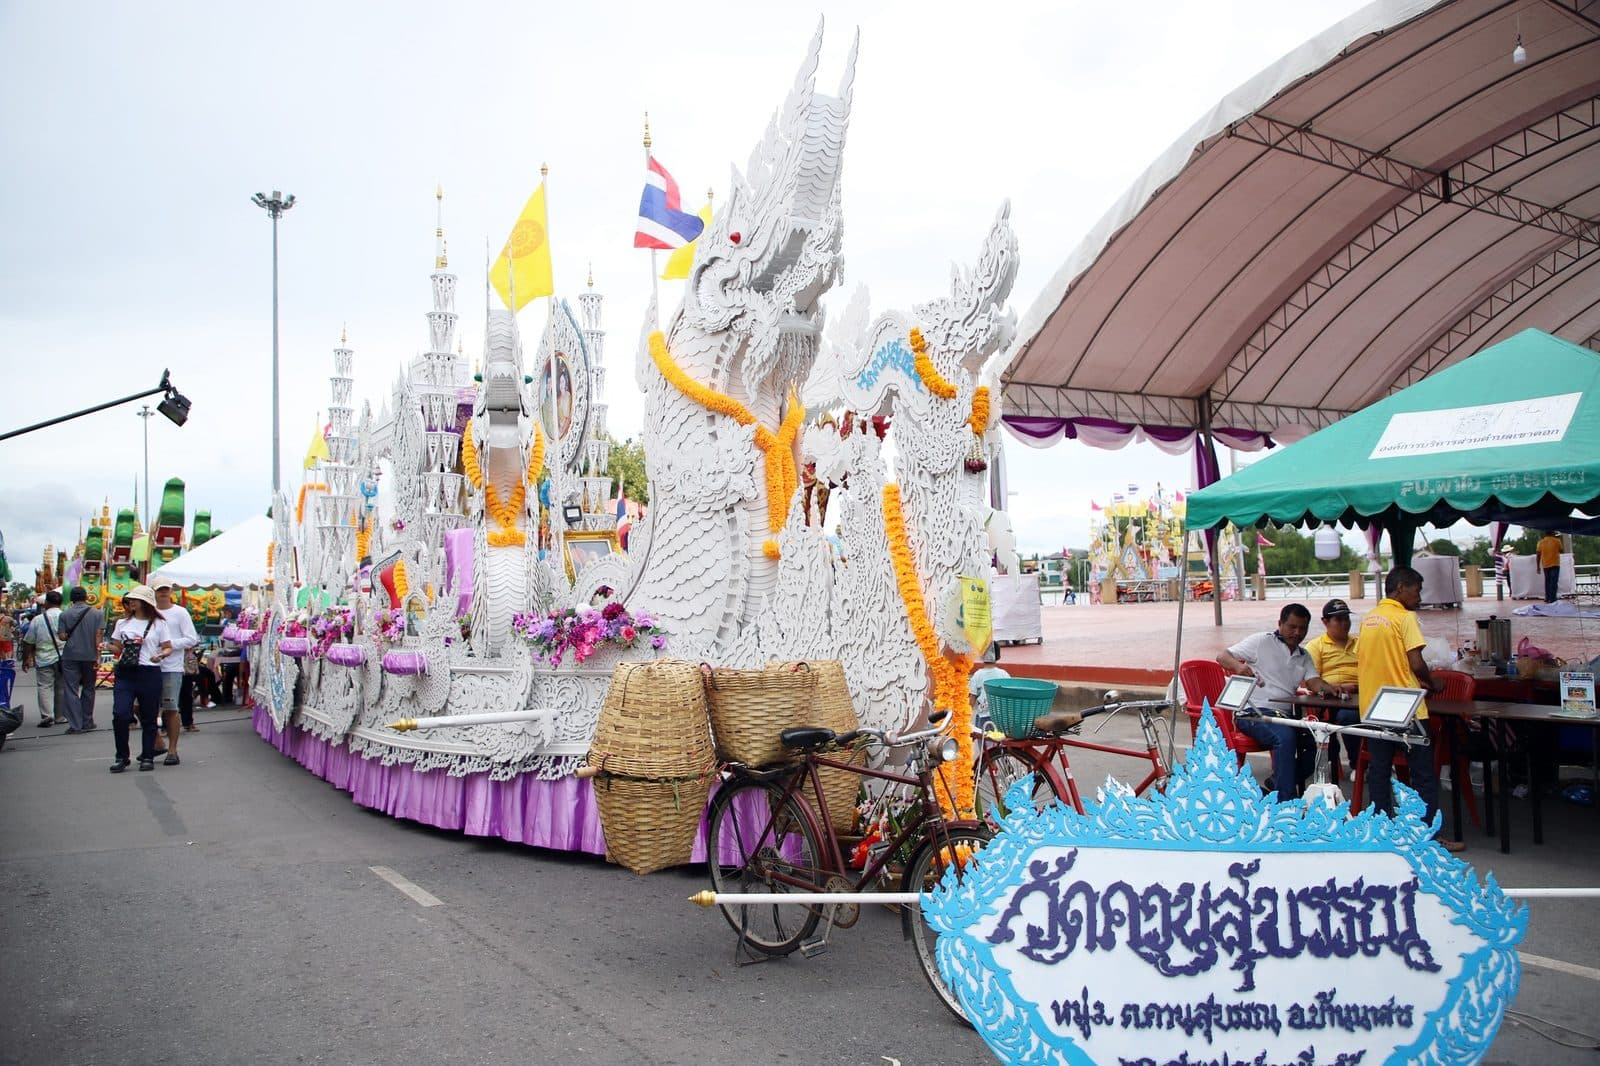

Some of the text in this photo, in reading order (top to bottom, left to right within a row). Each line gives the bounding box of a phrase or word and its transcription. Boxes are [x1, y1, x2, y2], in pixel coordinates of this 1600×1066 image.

[986, 848, 1442, 992] วัดควนสุบรรณ
